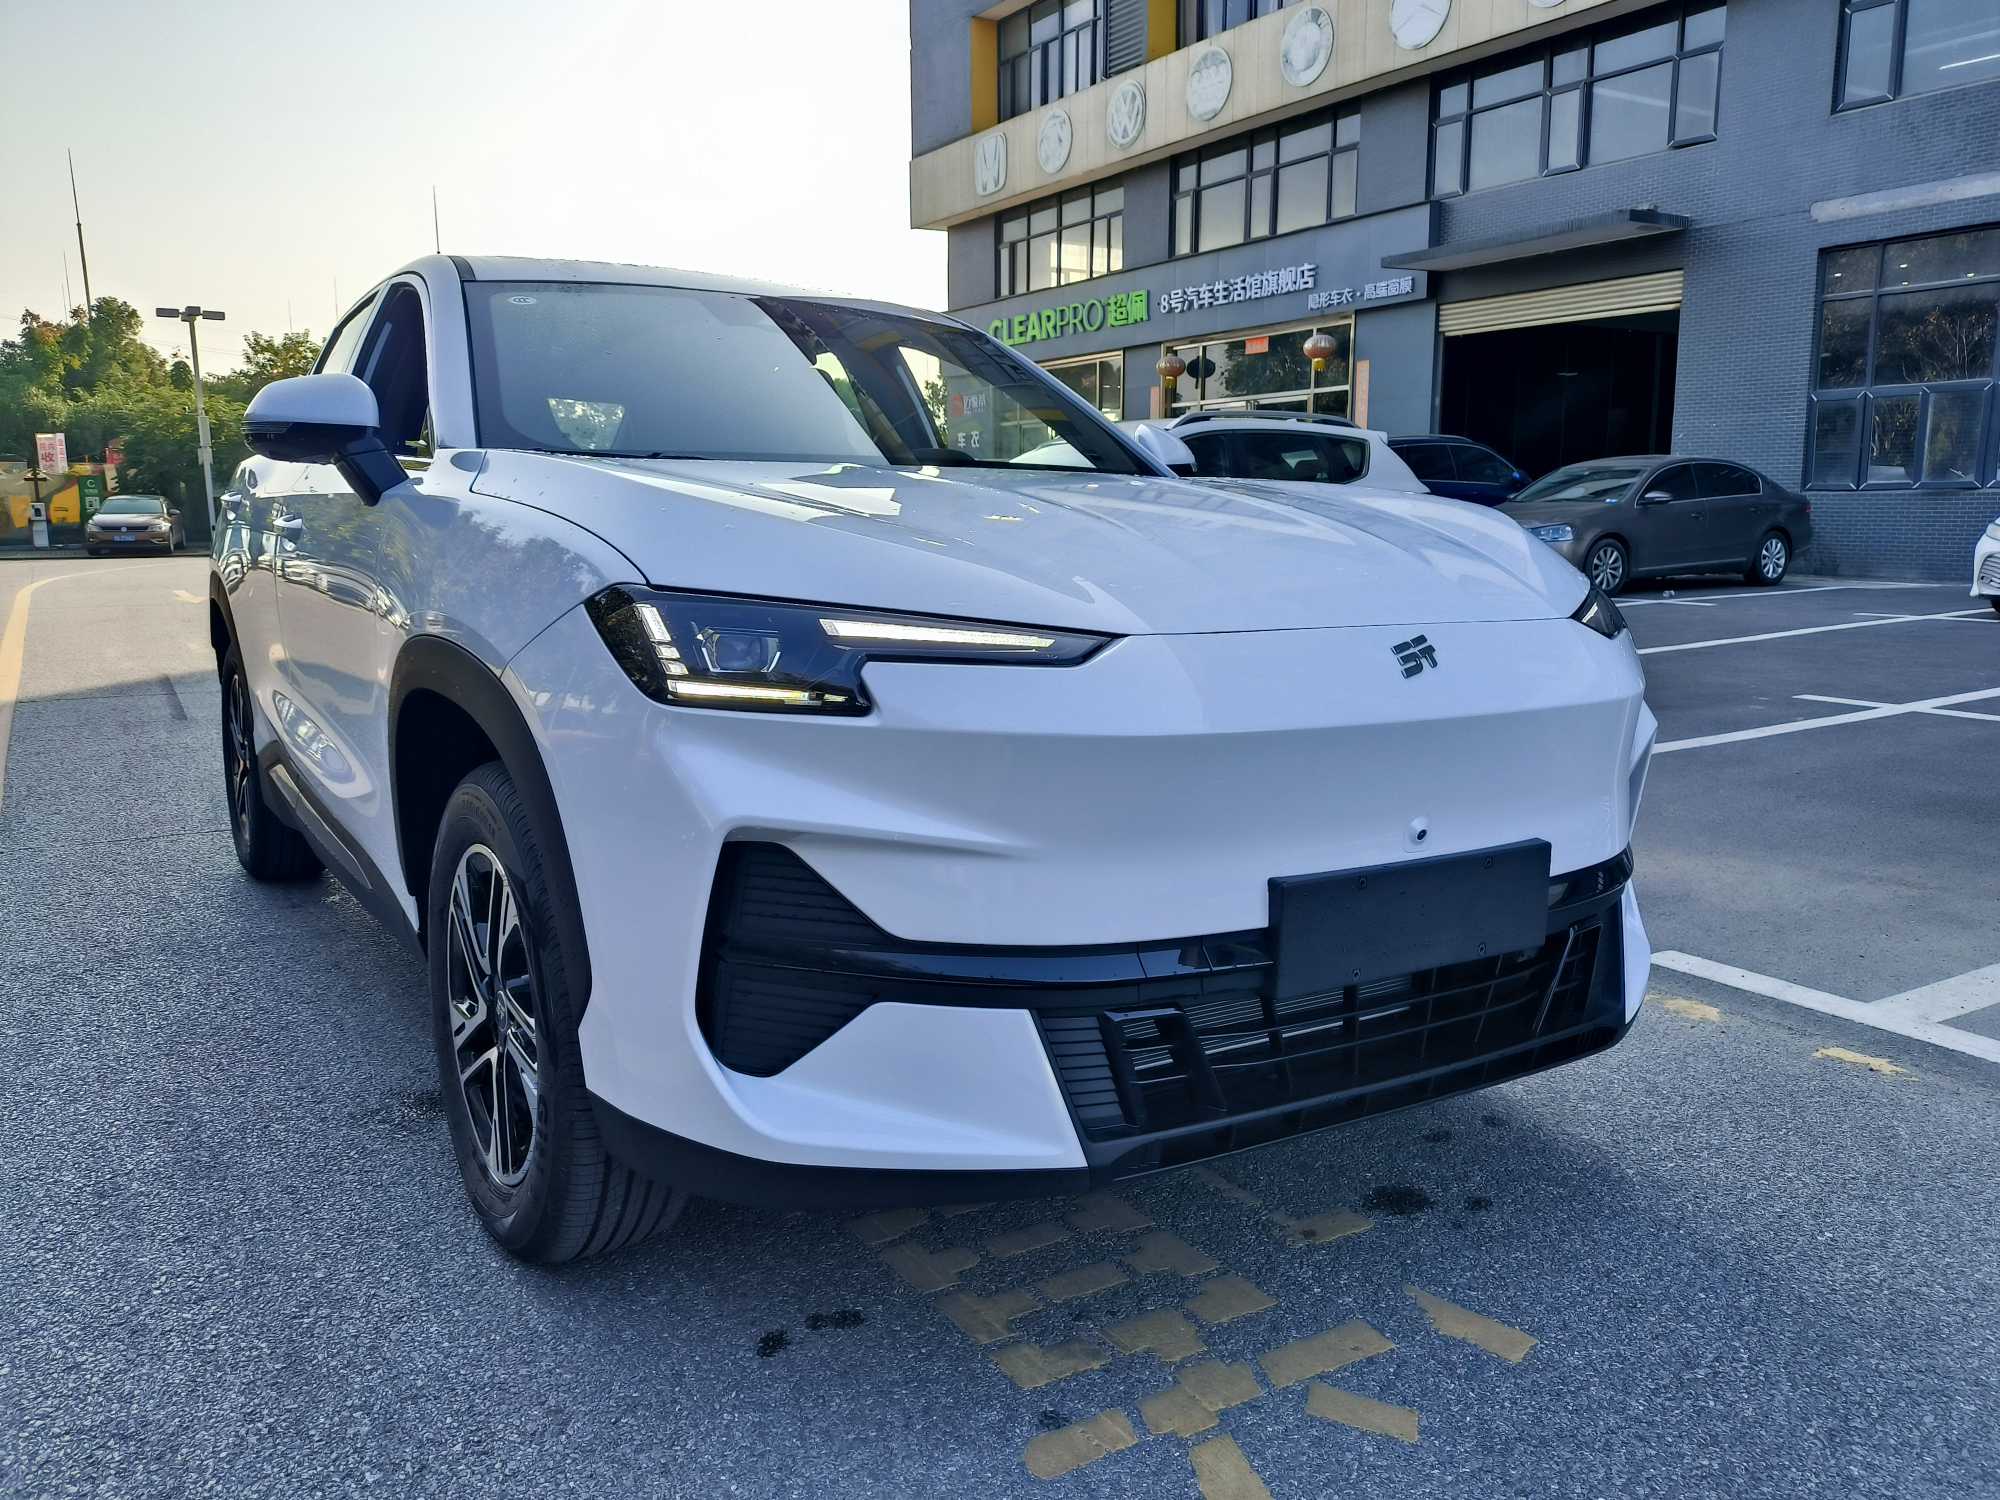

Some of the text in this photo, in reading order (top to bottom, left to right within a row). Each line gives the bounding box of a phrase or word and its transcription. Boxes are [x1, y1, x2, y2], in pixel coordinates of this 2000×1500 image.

[1160, 263, 1317, 313] 8号汽车生活馆旗舰店
[988, 299, 1104, 346] CLEARPRO
